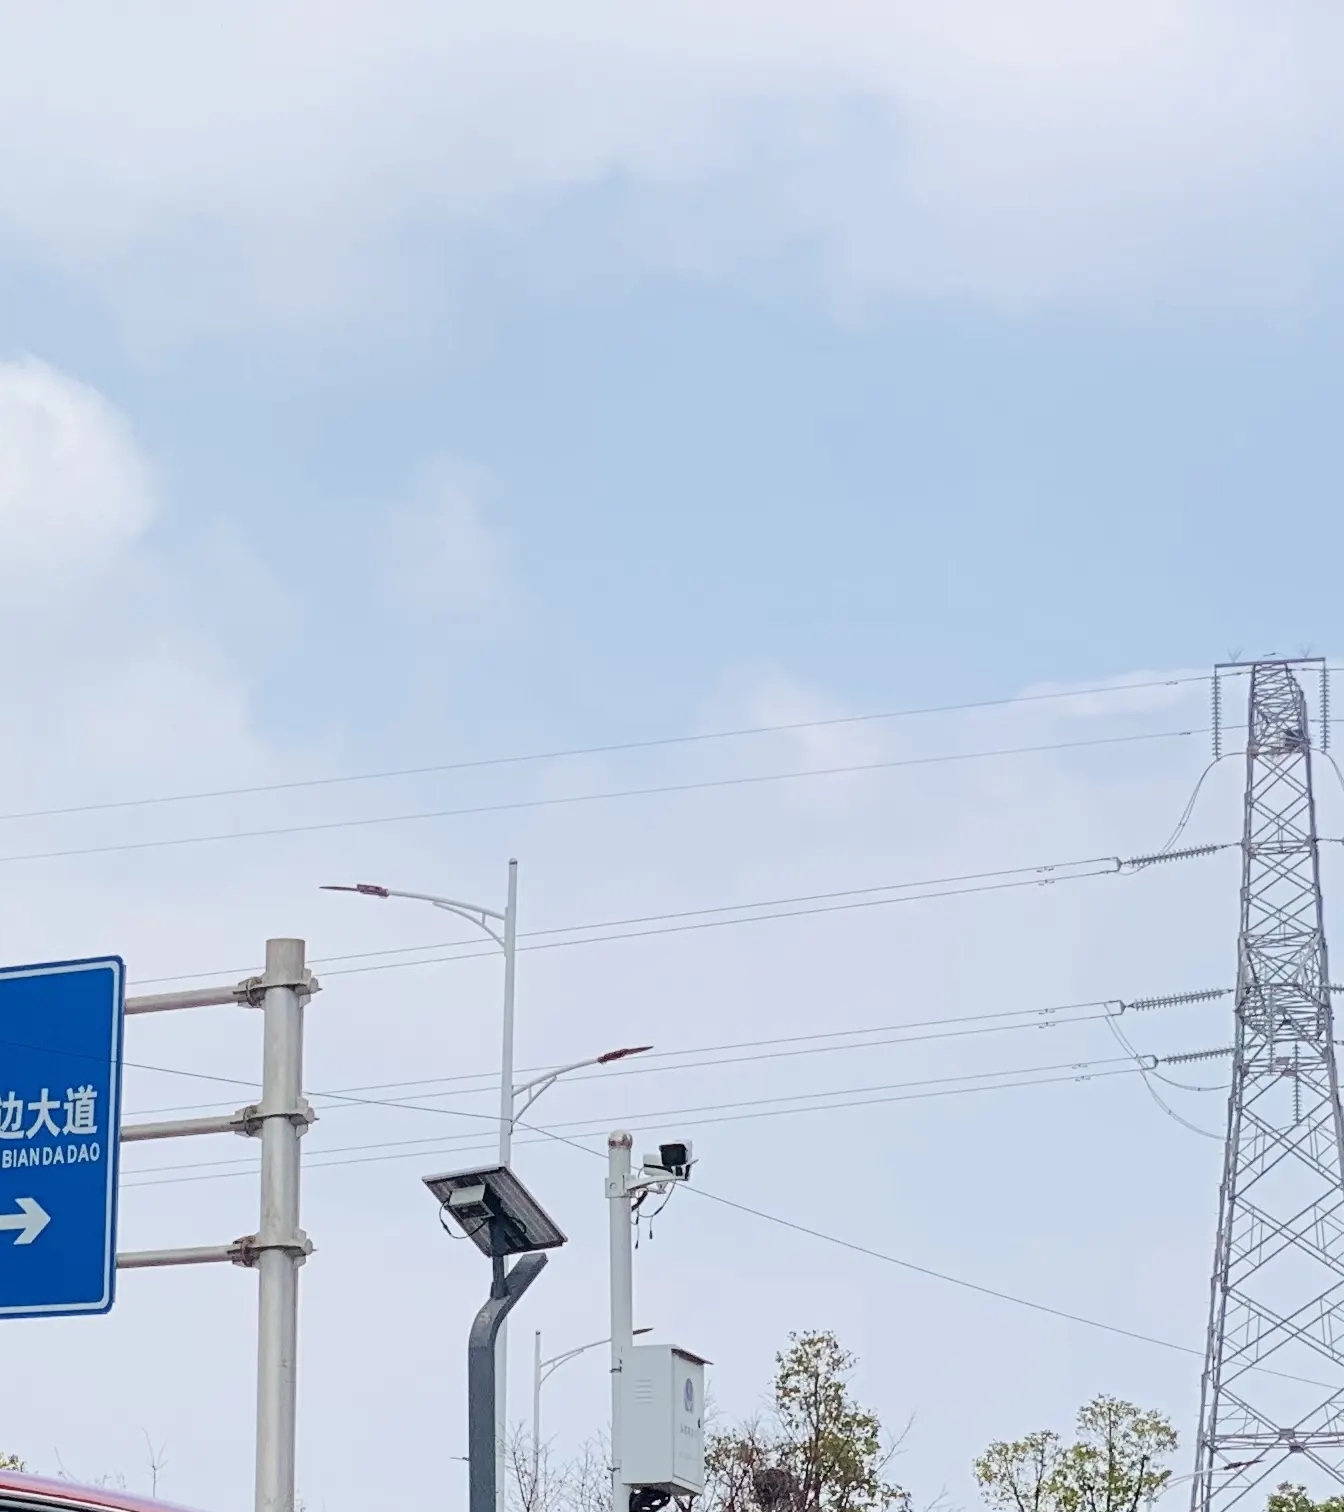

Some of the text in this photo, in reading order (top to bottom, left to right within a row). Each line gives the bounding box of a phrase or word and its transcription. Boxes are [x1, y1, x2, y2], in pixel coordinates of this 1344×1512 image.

[1, 1147, 40, 1169] BIAN
[42, 1145, 65, 1166] DA
[67, 1141, 100, 1164] DAO
